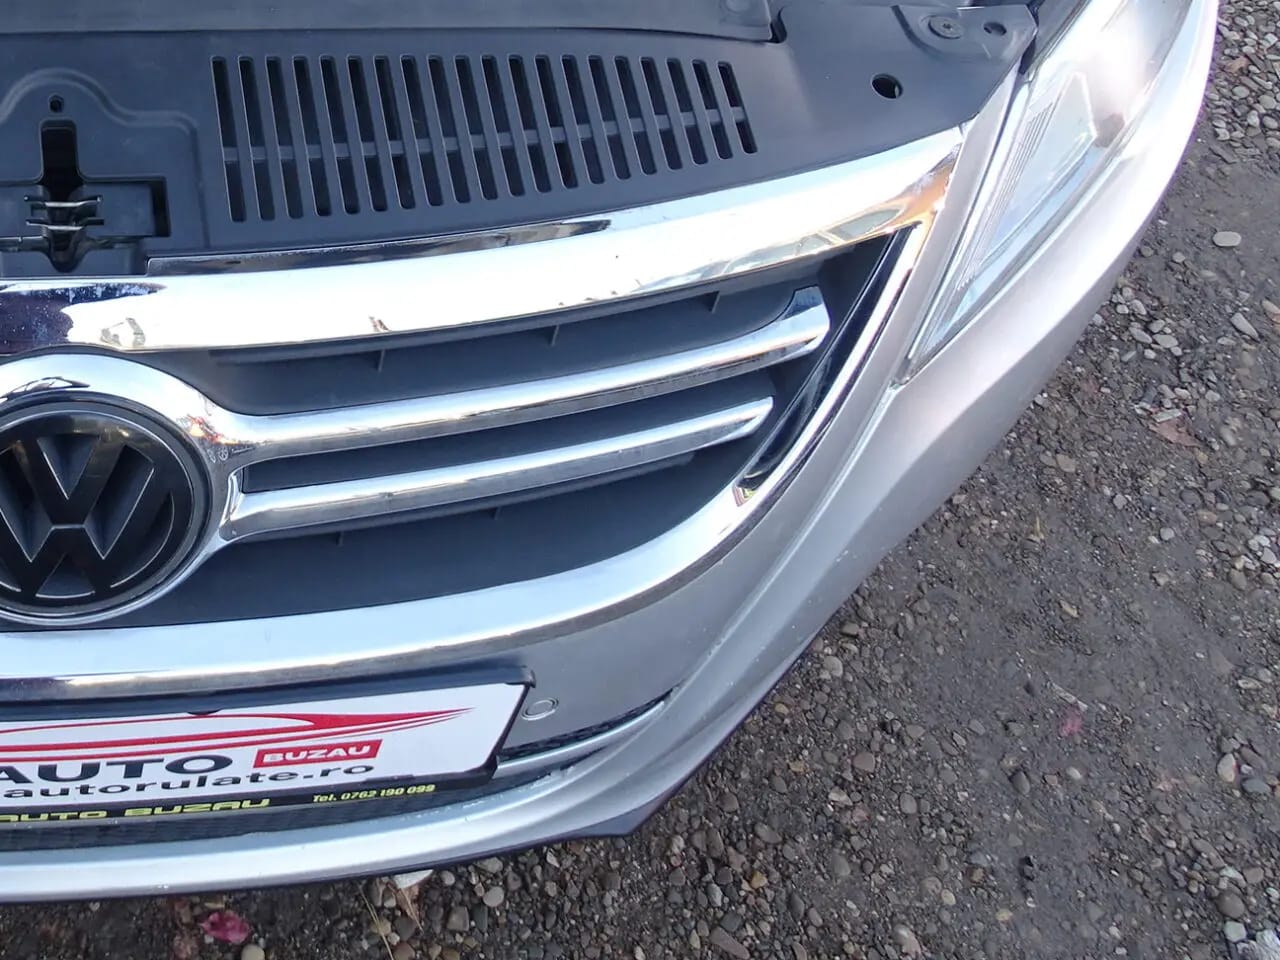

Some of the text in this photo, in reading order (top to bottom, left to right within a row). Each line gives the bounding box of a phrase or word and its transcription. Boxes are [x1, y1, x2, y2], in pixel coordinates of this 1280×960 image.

[262, 744, 371, 763] BUZAU
[313, 783, 437, 803] Tel. 0762 190 099
[123, 798, 272, 817] BUZAU
